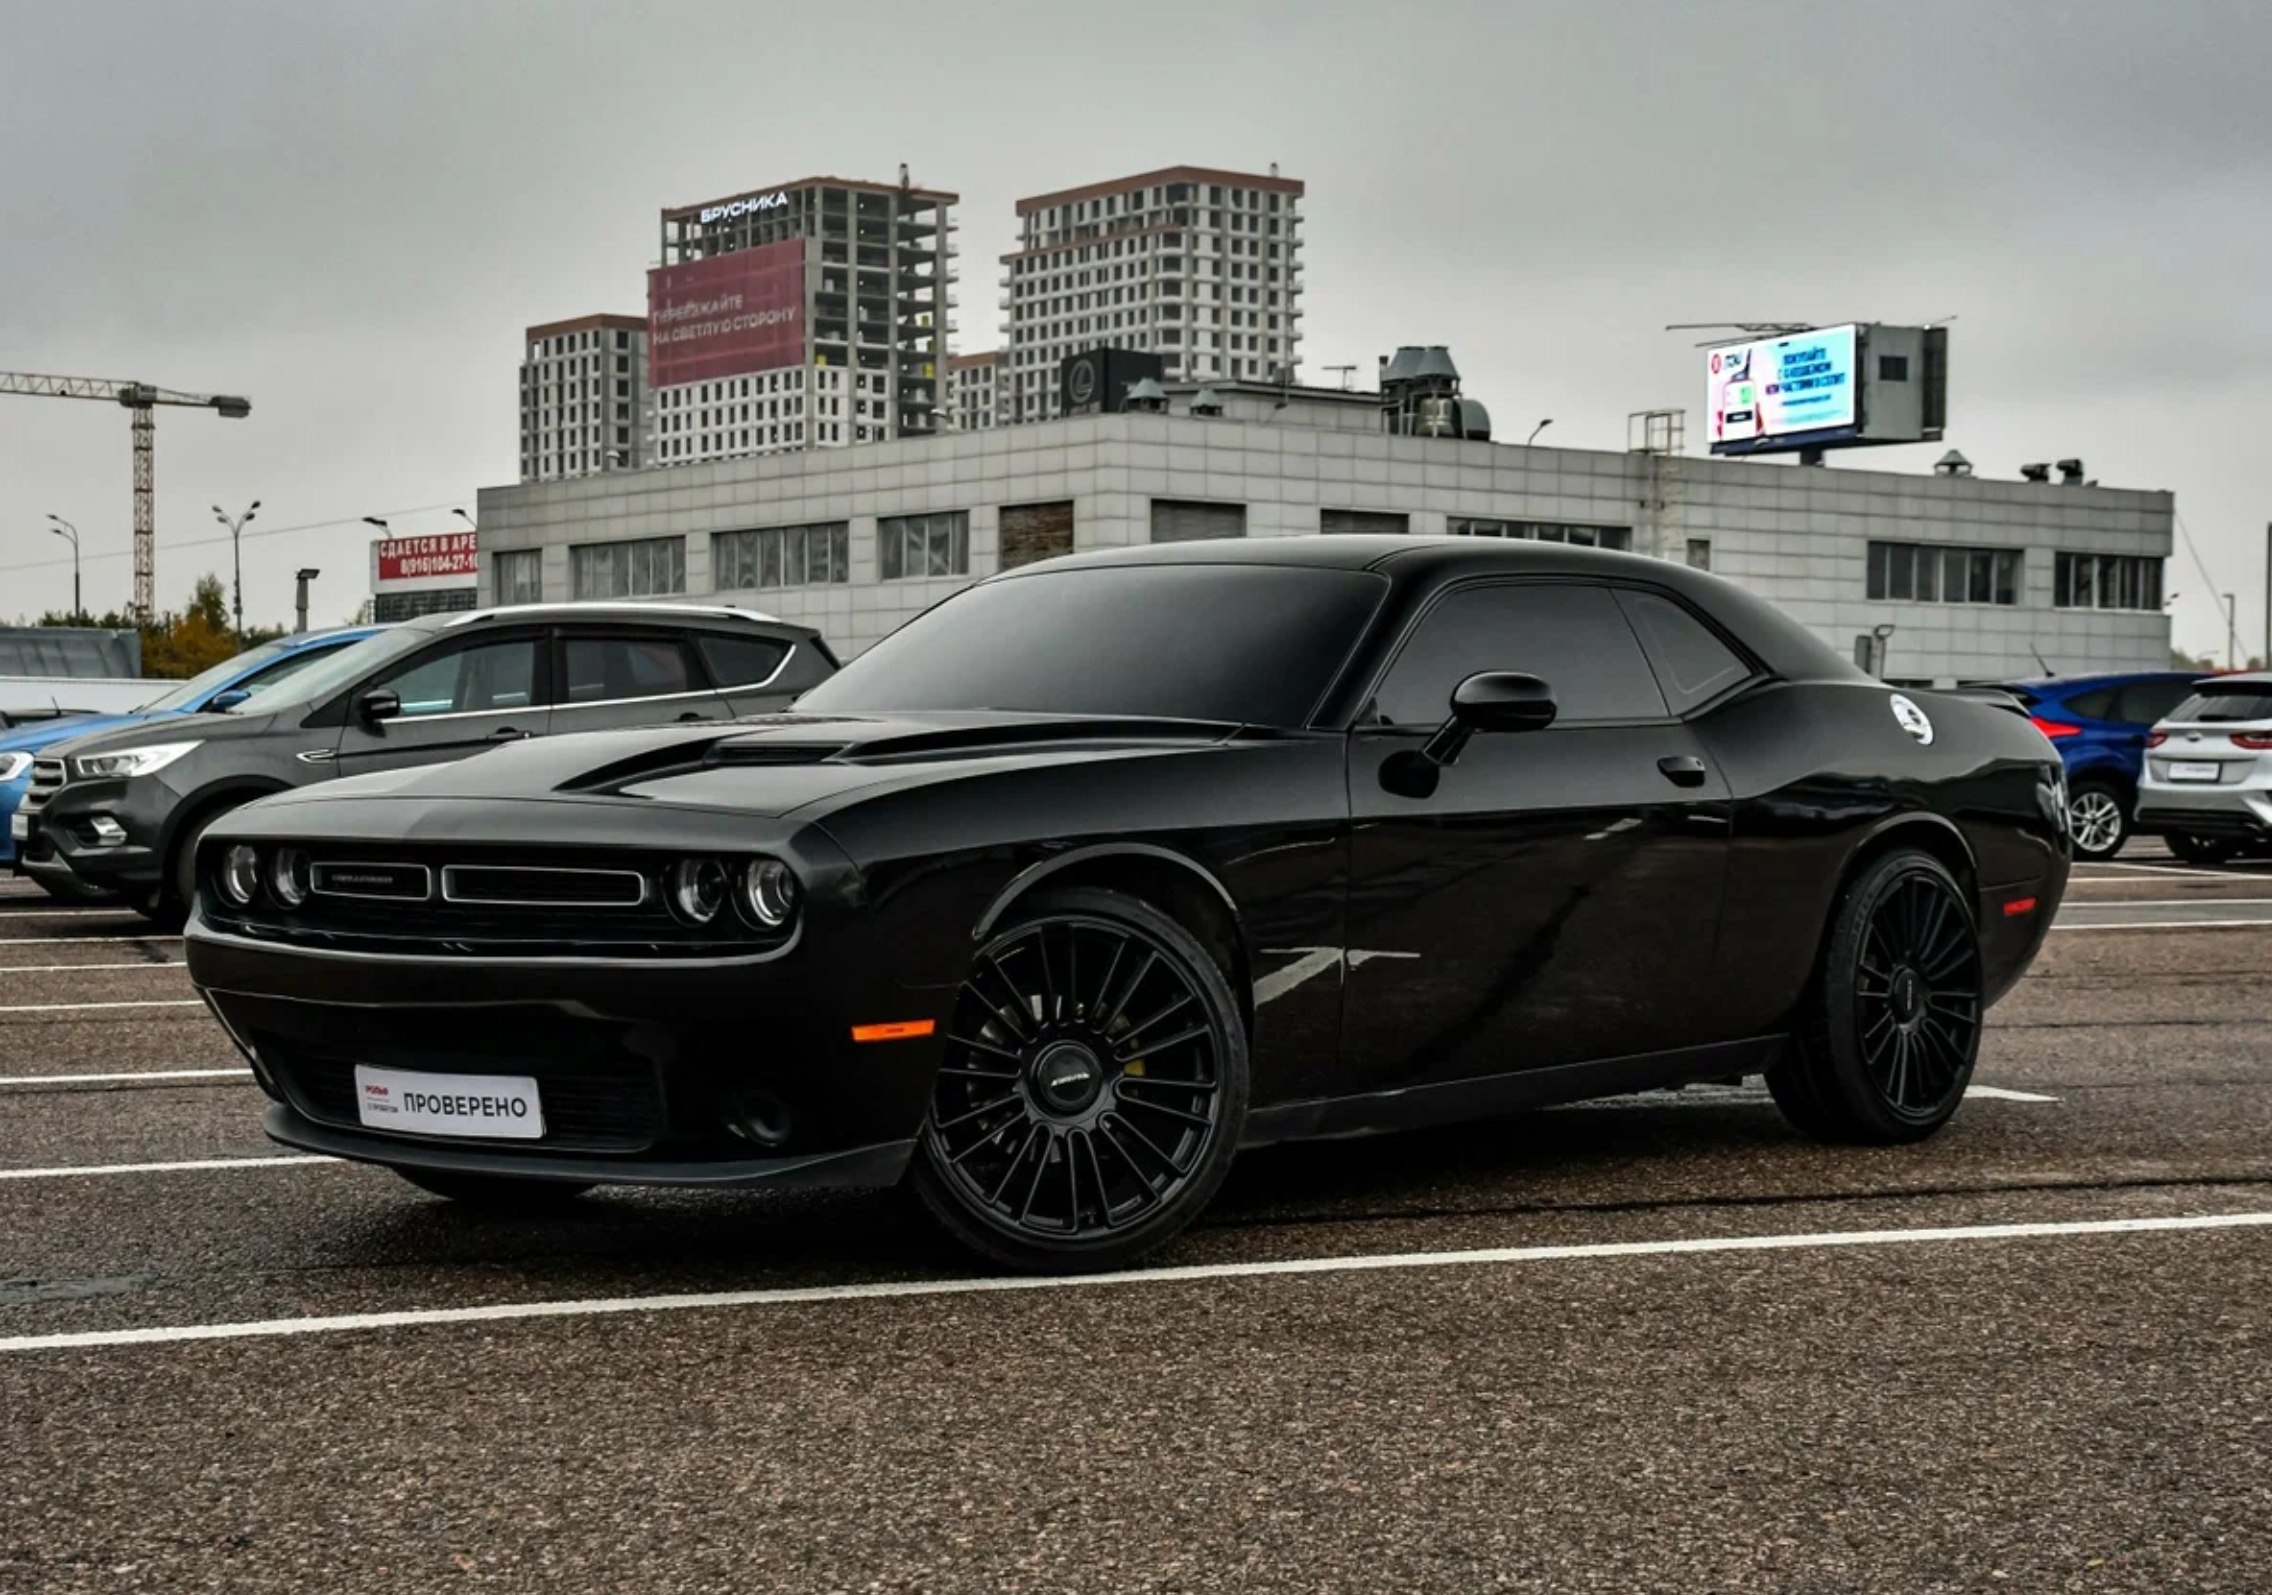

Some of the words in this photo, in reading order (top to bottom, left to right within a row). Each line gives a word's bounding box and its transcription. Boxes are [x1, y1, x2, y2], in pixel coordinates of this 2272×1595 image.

[701, 191, 788, 223] БРУСНИКА
[653, 294, 743, 325] ПЕРЕЕЗЖАЙТЕ
[653, 331, 670, 346] НА
[672, 319, 732, 341] СВЕТЛУЮ
[733, 306, 796, 330] СТОРОНУ
[380, 538, 437, 559] СДАЕТСЯ
[403, 1092, 527, 1118] ПРОВЕРЕНО
